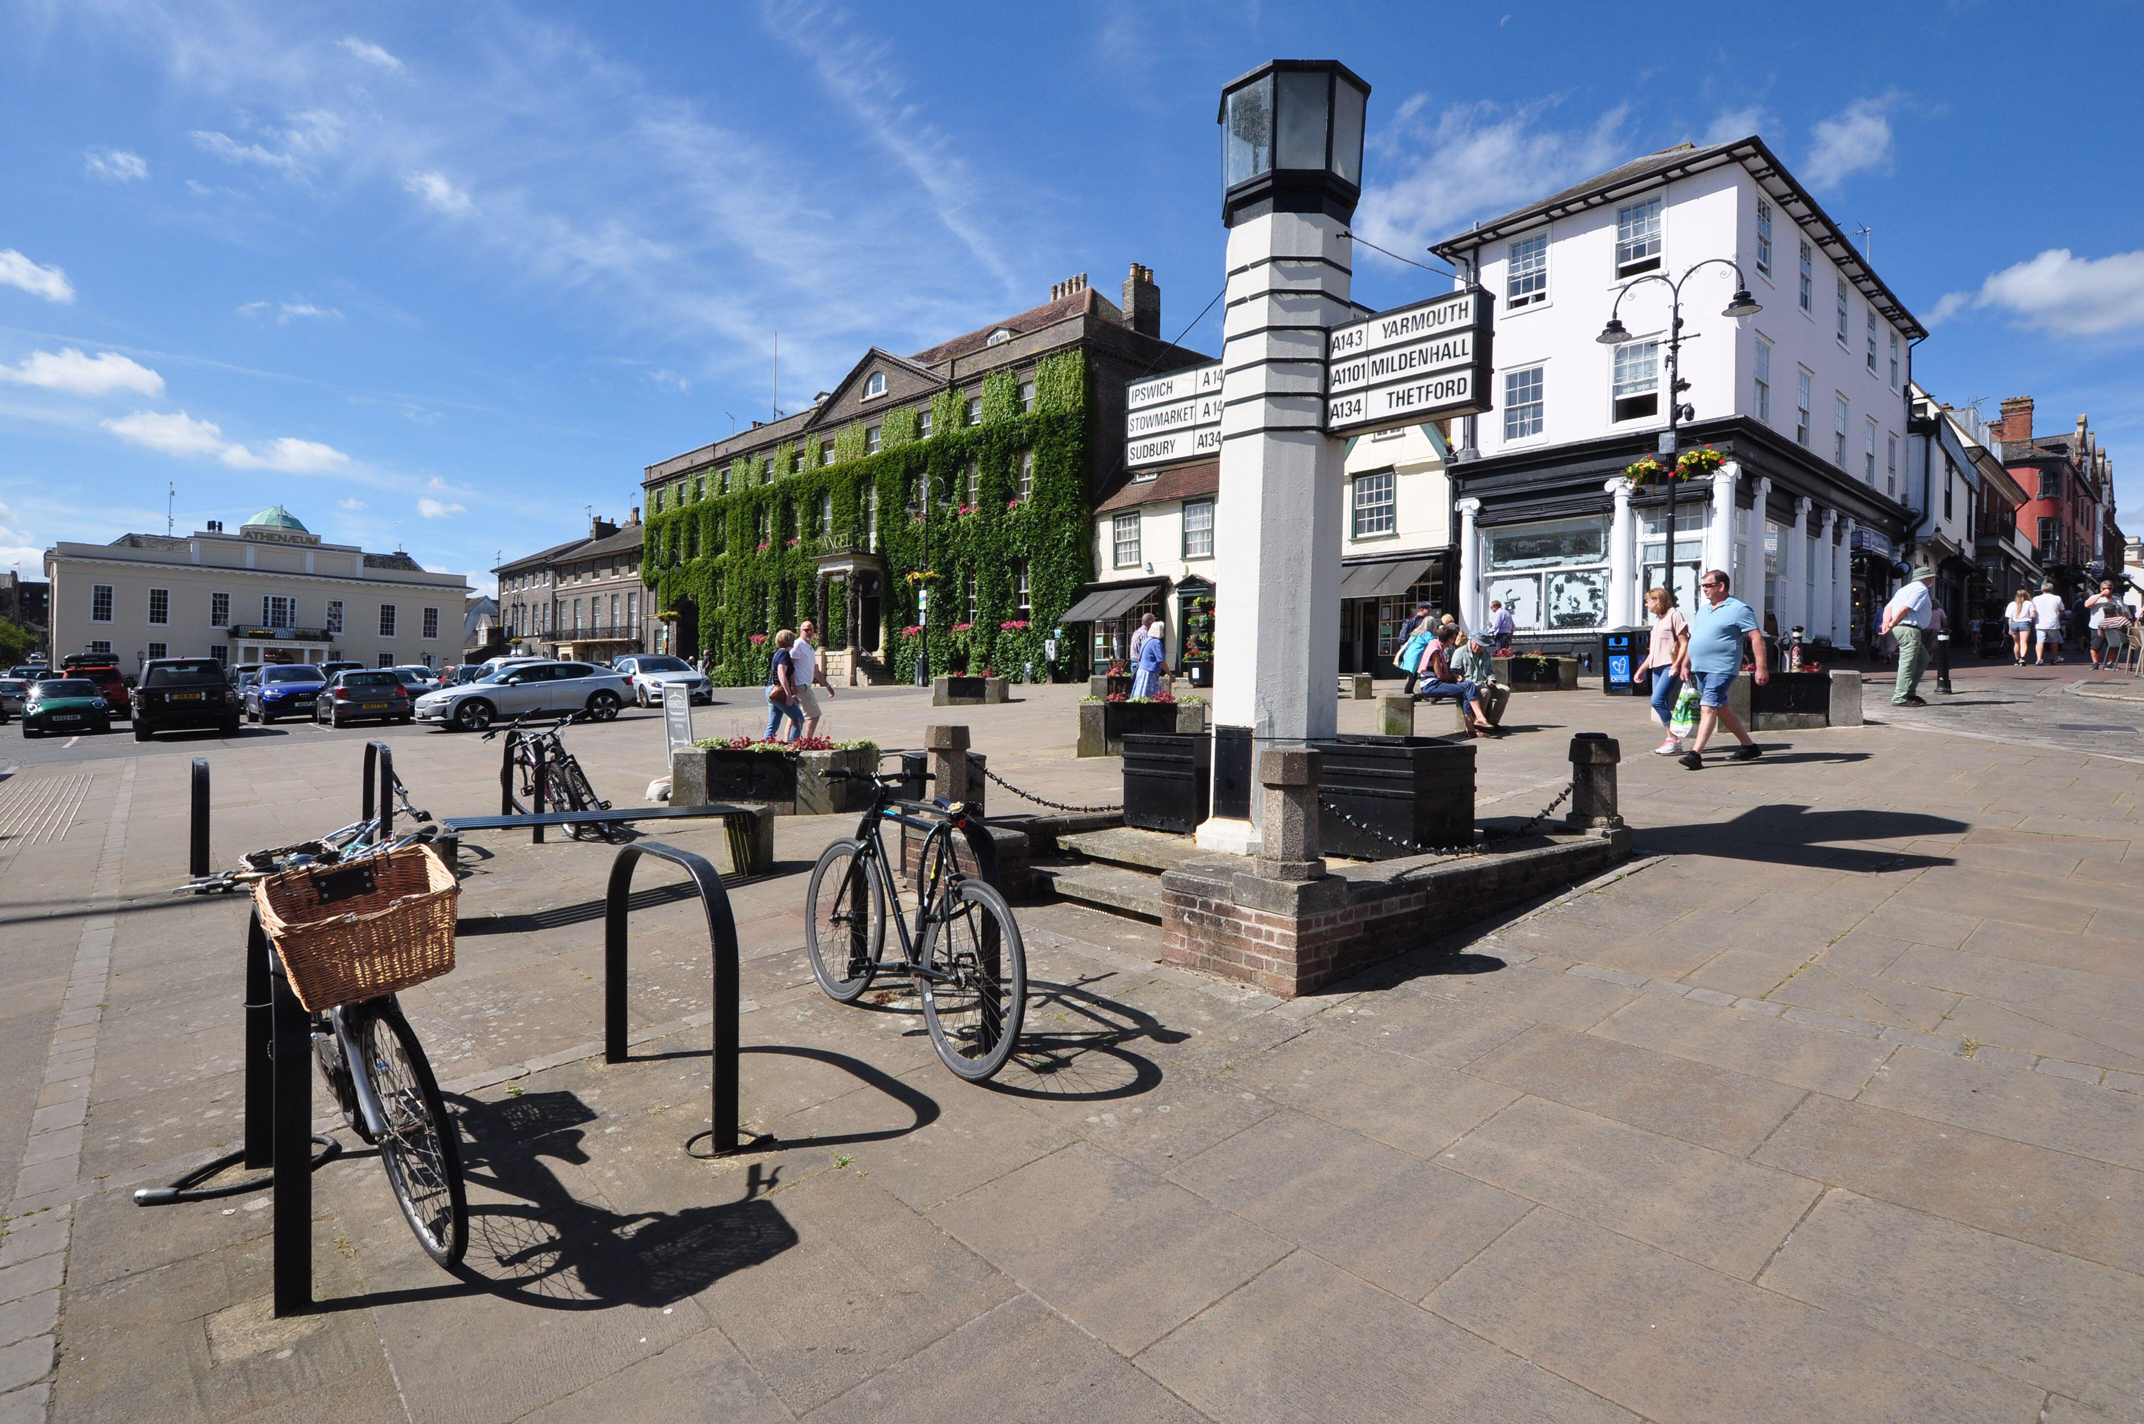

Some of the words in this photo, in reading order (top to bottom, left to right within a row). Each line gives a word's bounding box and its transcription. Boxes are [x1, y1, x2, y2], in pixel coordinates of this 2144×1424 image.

[1331, 329, 1363, 354] A143
[1381, 300, 1469, 339] YARMOUTH
[1331, 363, 1366, 387] A1101
[1371, 338, 1470, 377] MILDENHALL
[1131, 380, 1173, 403] IPSWICH
[1330, 398, 1362, 420] A134
[1386, 377, 1467, 409] THETFORD
[1129, 405, 1195, 432] STOWMARKET
[1129, 439, 1176, 461] SUDBURY
[1197, 430, 1221, 449] A134
[243, 530, 318, 546] ATHENÆUM
